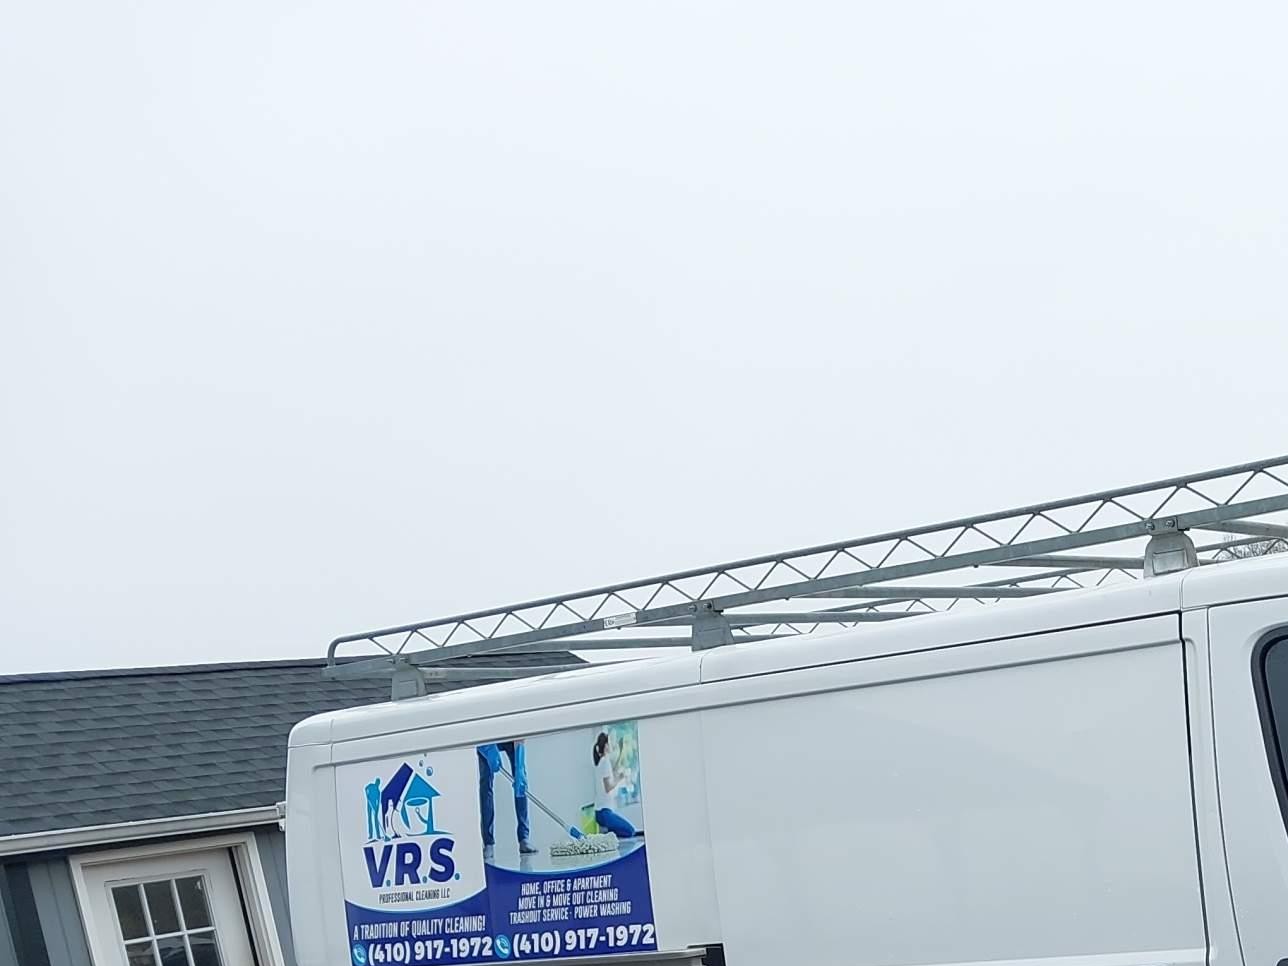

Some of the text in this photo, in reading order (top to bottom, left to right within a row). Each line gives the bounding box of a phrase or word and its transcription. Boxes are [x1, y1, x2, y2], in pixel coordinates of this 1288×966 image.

[363, 837, 461, 889] V.R.S.
[379, 887, 451, 904] PROFESSIONAL CLEANING LLC
[543, 879, 565, 893] OFFICE
[572, 874, 612, 891] APARTMENT
[518, 896, 536, 911] MOVE
[537, 896, 545, 909] IN
[552, 893, 571, 907] MOVE
[572, 892, 585, 905] OUT
[586, 888, 618, 904] CLEANING
[510, 910, 541, 925] TRASHOUT
[542, 907, 569, 922] SERVICE
[574, 905, 598, 919] POWER
[599, 901, 632, 916] WASHING
[353, 915, 486, 940] A TRADITION OF QUALITY CLEANING!
[368, 936, 493, 966] (410) 917-1972
[512, 923, 655, 958] (410) 917-1972
